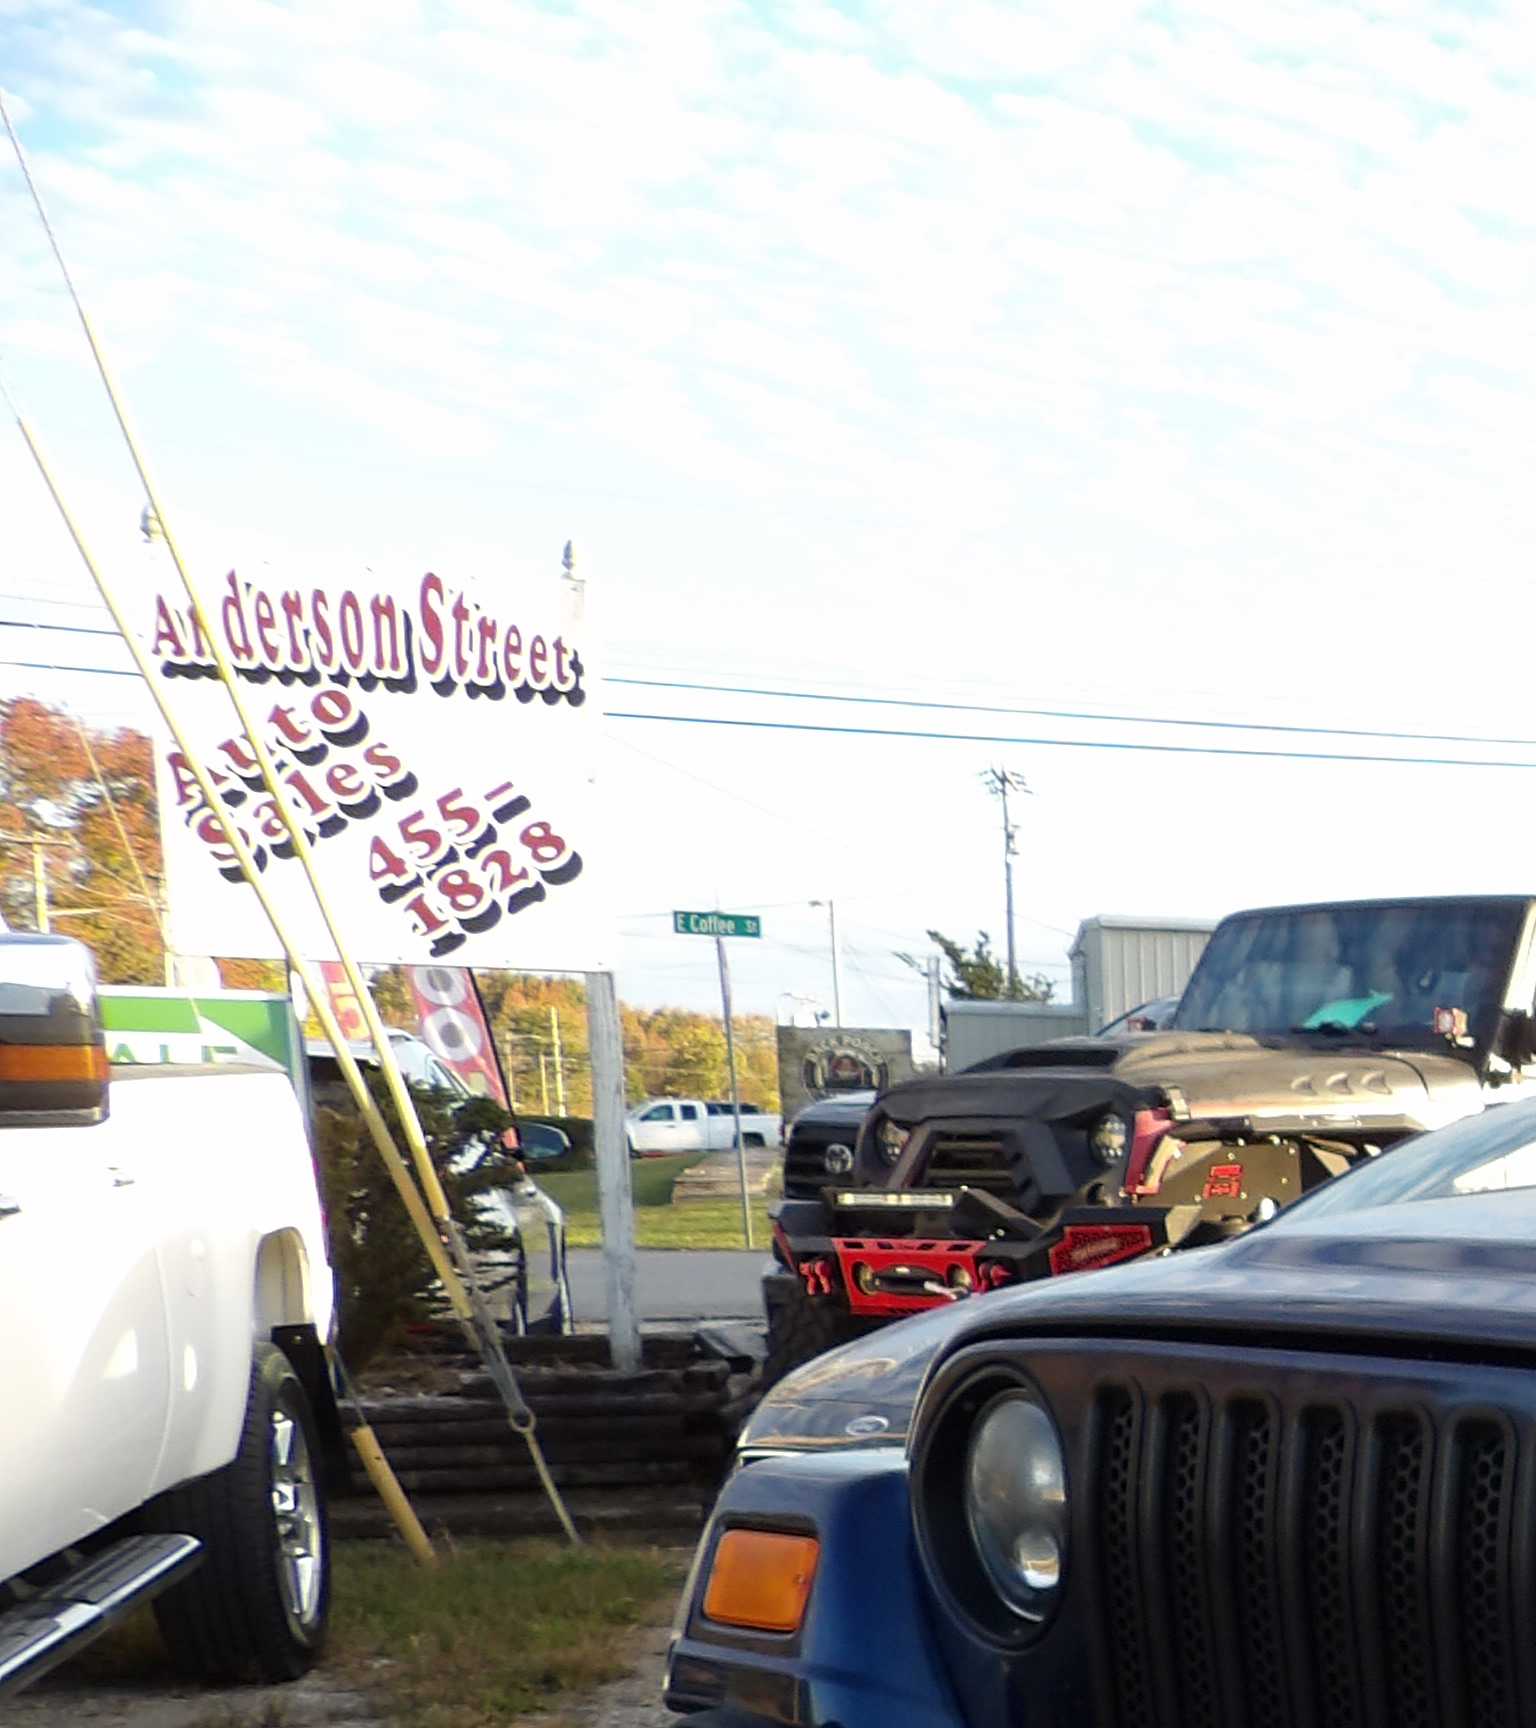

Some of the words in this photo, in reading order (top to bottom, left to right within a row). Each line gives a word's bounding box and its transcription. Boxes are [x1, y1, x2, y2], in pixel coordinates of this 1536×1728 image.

[151, 568, 410, 685] Anderson
[420, 571, 579, 696] Street
[166, 690, 358, 808] Auto
[196, 742, 409, 870] Sales
[404, 821, 573, 945] 1828
[676, 914, 687, 932] E
[689, 914, 736, 934] Coffee
